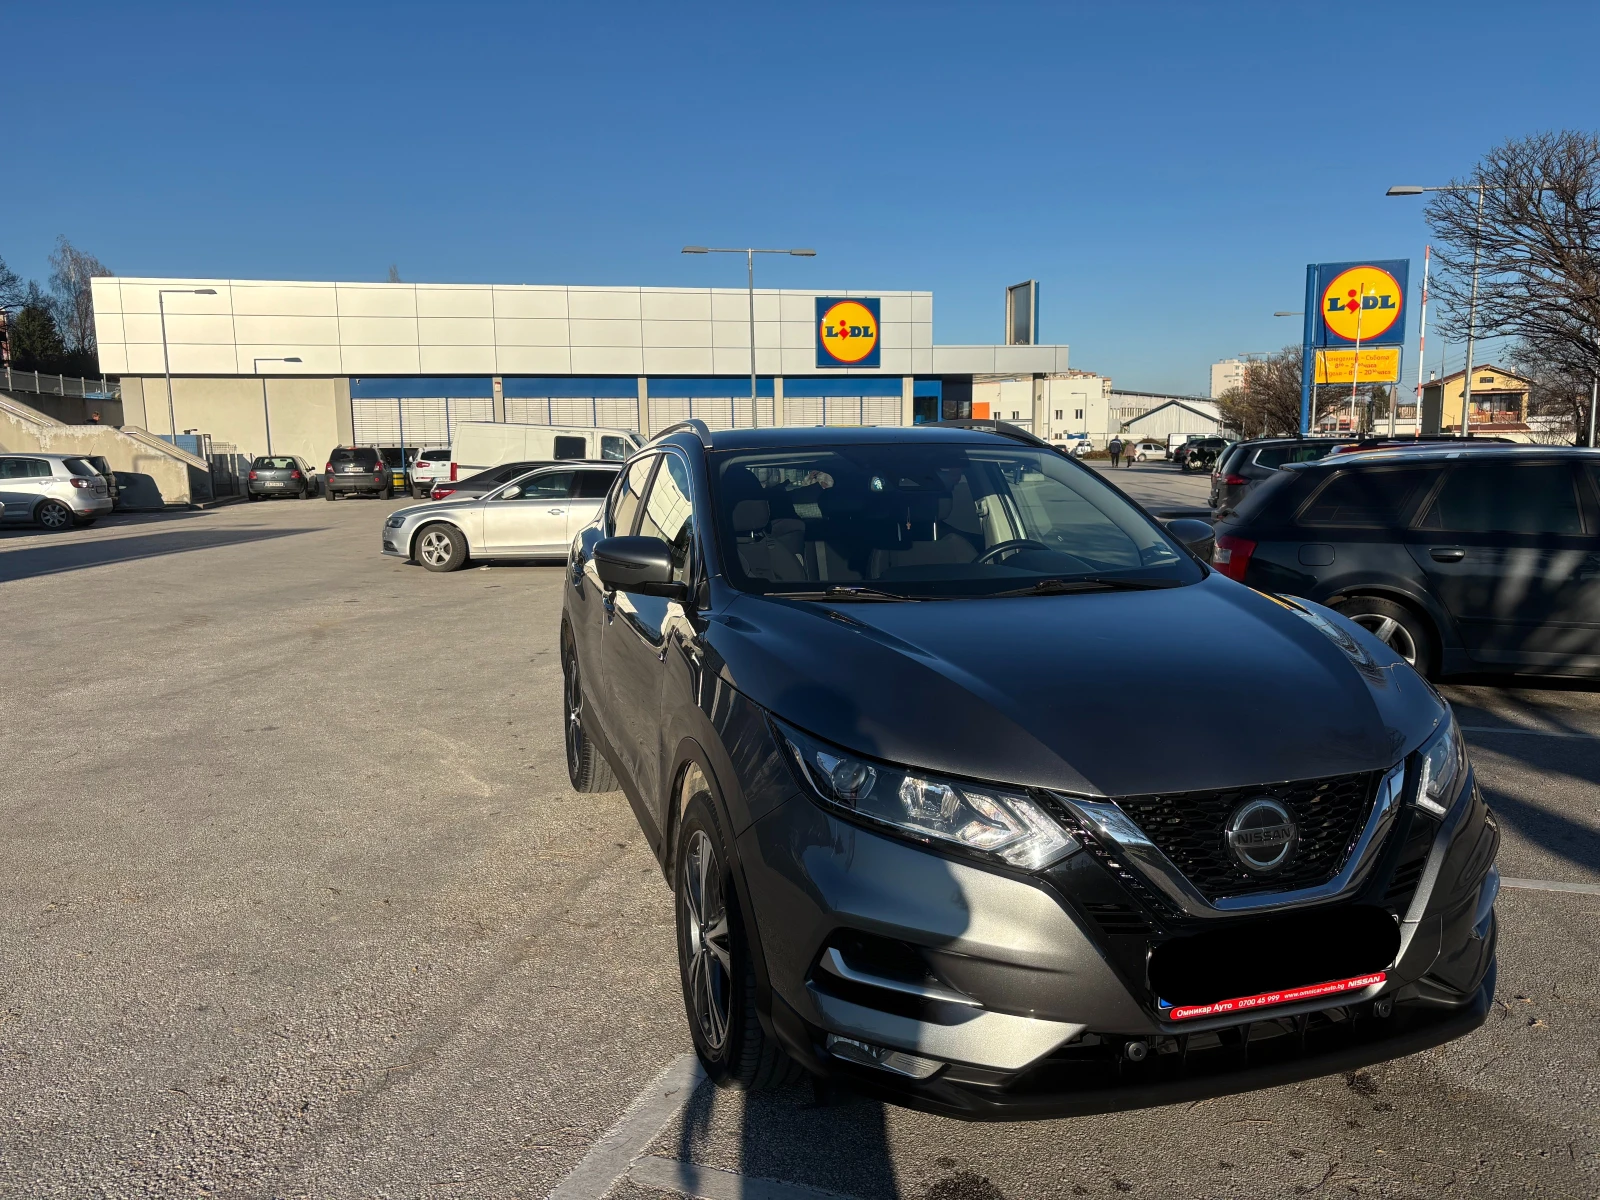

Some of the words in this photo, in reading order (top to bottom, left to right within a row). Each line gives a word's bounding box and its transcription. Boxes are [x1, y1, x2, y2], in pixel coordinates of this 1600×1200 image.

[1237, 827, 1291, 844] NISSAN
[1176, 1005, 1212, 1017] Омникар
[1213, 1003, 1233, 1012] Ауто
[1238, 998, 1256, 1007] 0700
[1267, 994, 1280, 1002] 999
[1284, 983, 1345, 999] www.omnicar-auto.bg
[1347, 976, 1381, 987] NISSAN
